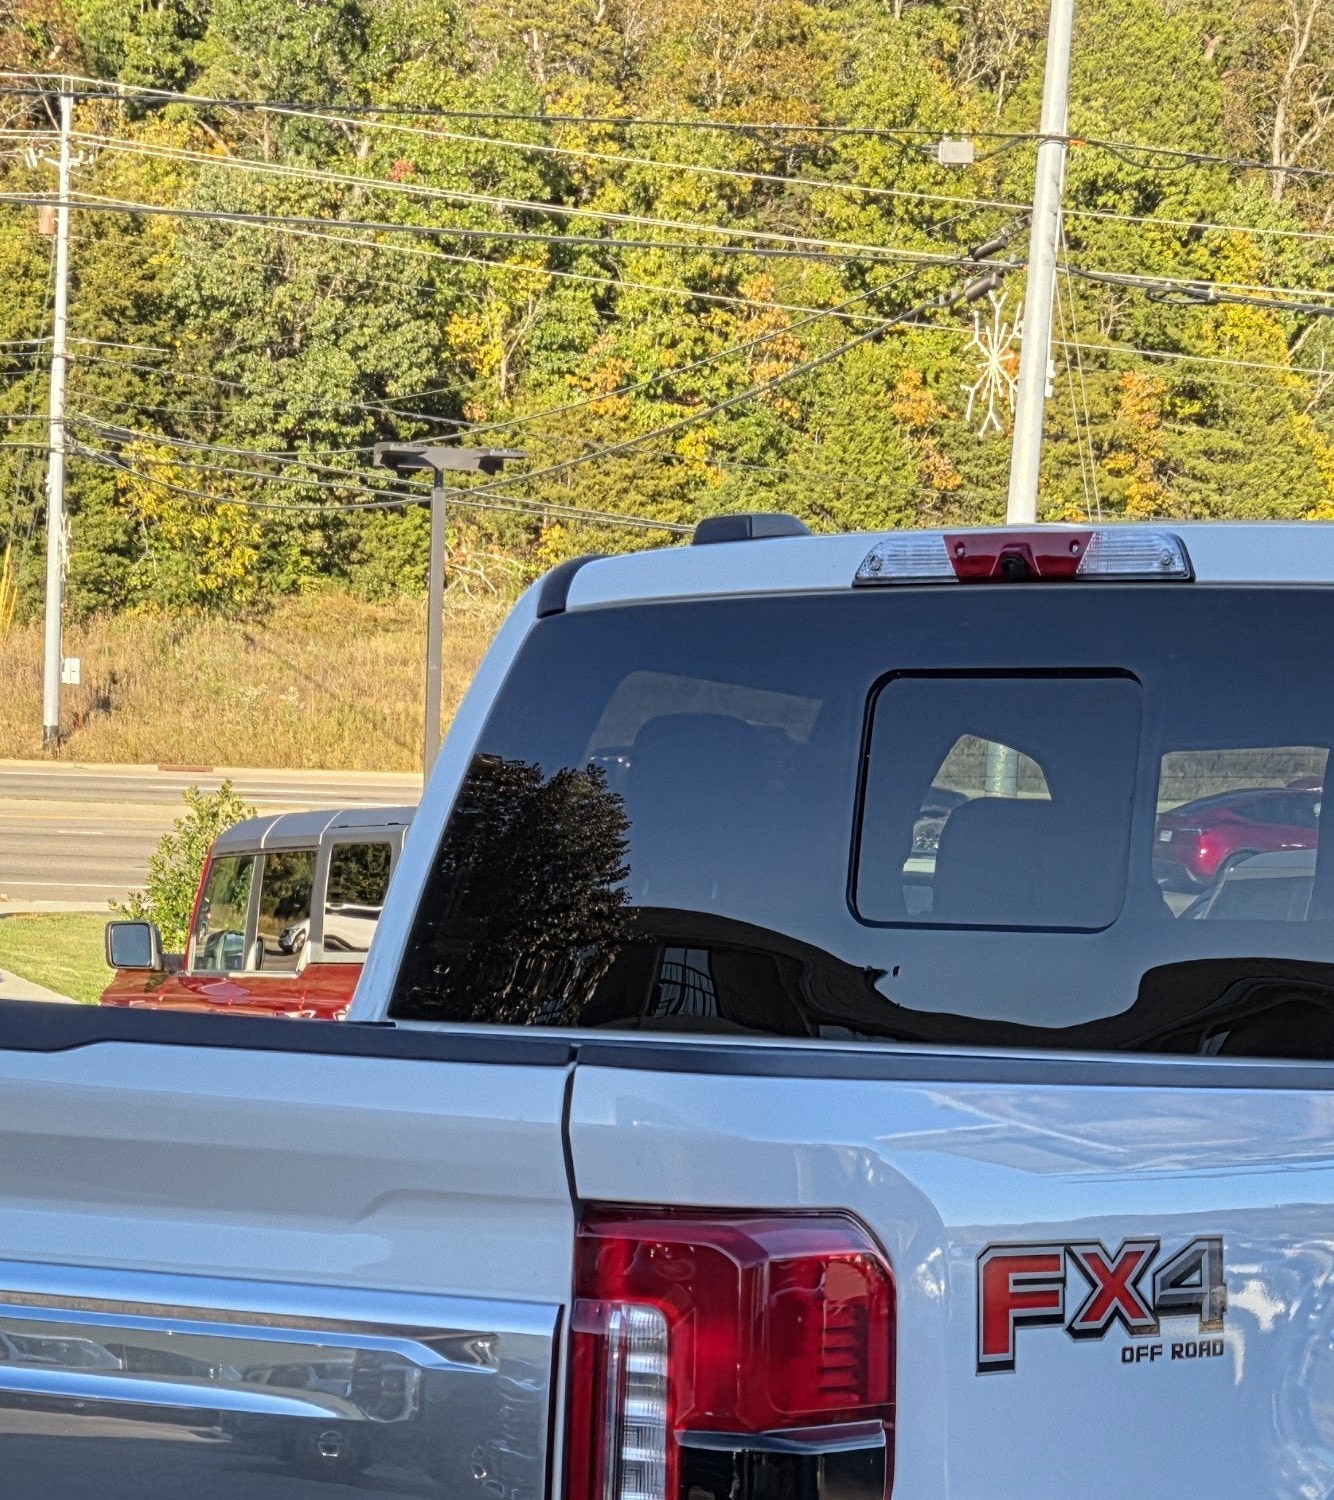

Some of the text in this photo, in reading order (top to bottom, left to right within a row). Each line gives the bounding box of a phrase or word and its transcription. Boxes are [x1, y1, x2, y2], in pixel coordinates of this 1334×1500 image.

[975, 1233, 1227, 1377] FX4
[1121, 1338, 1225, 1364] OFF ROAD
